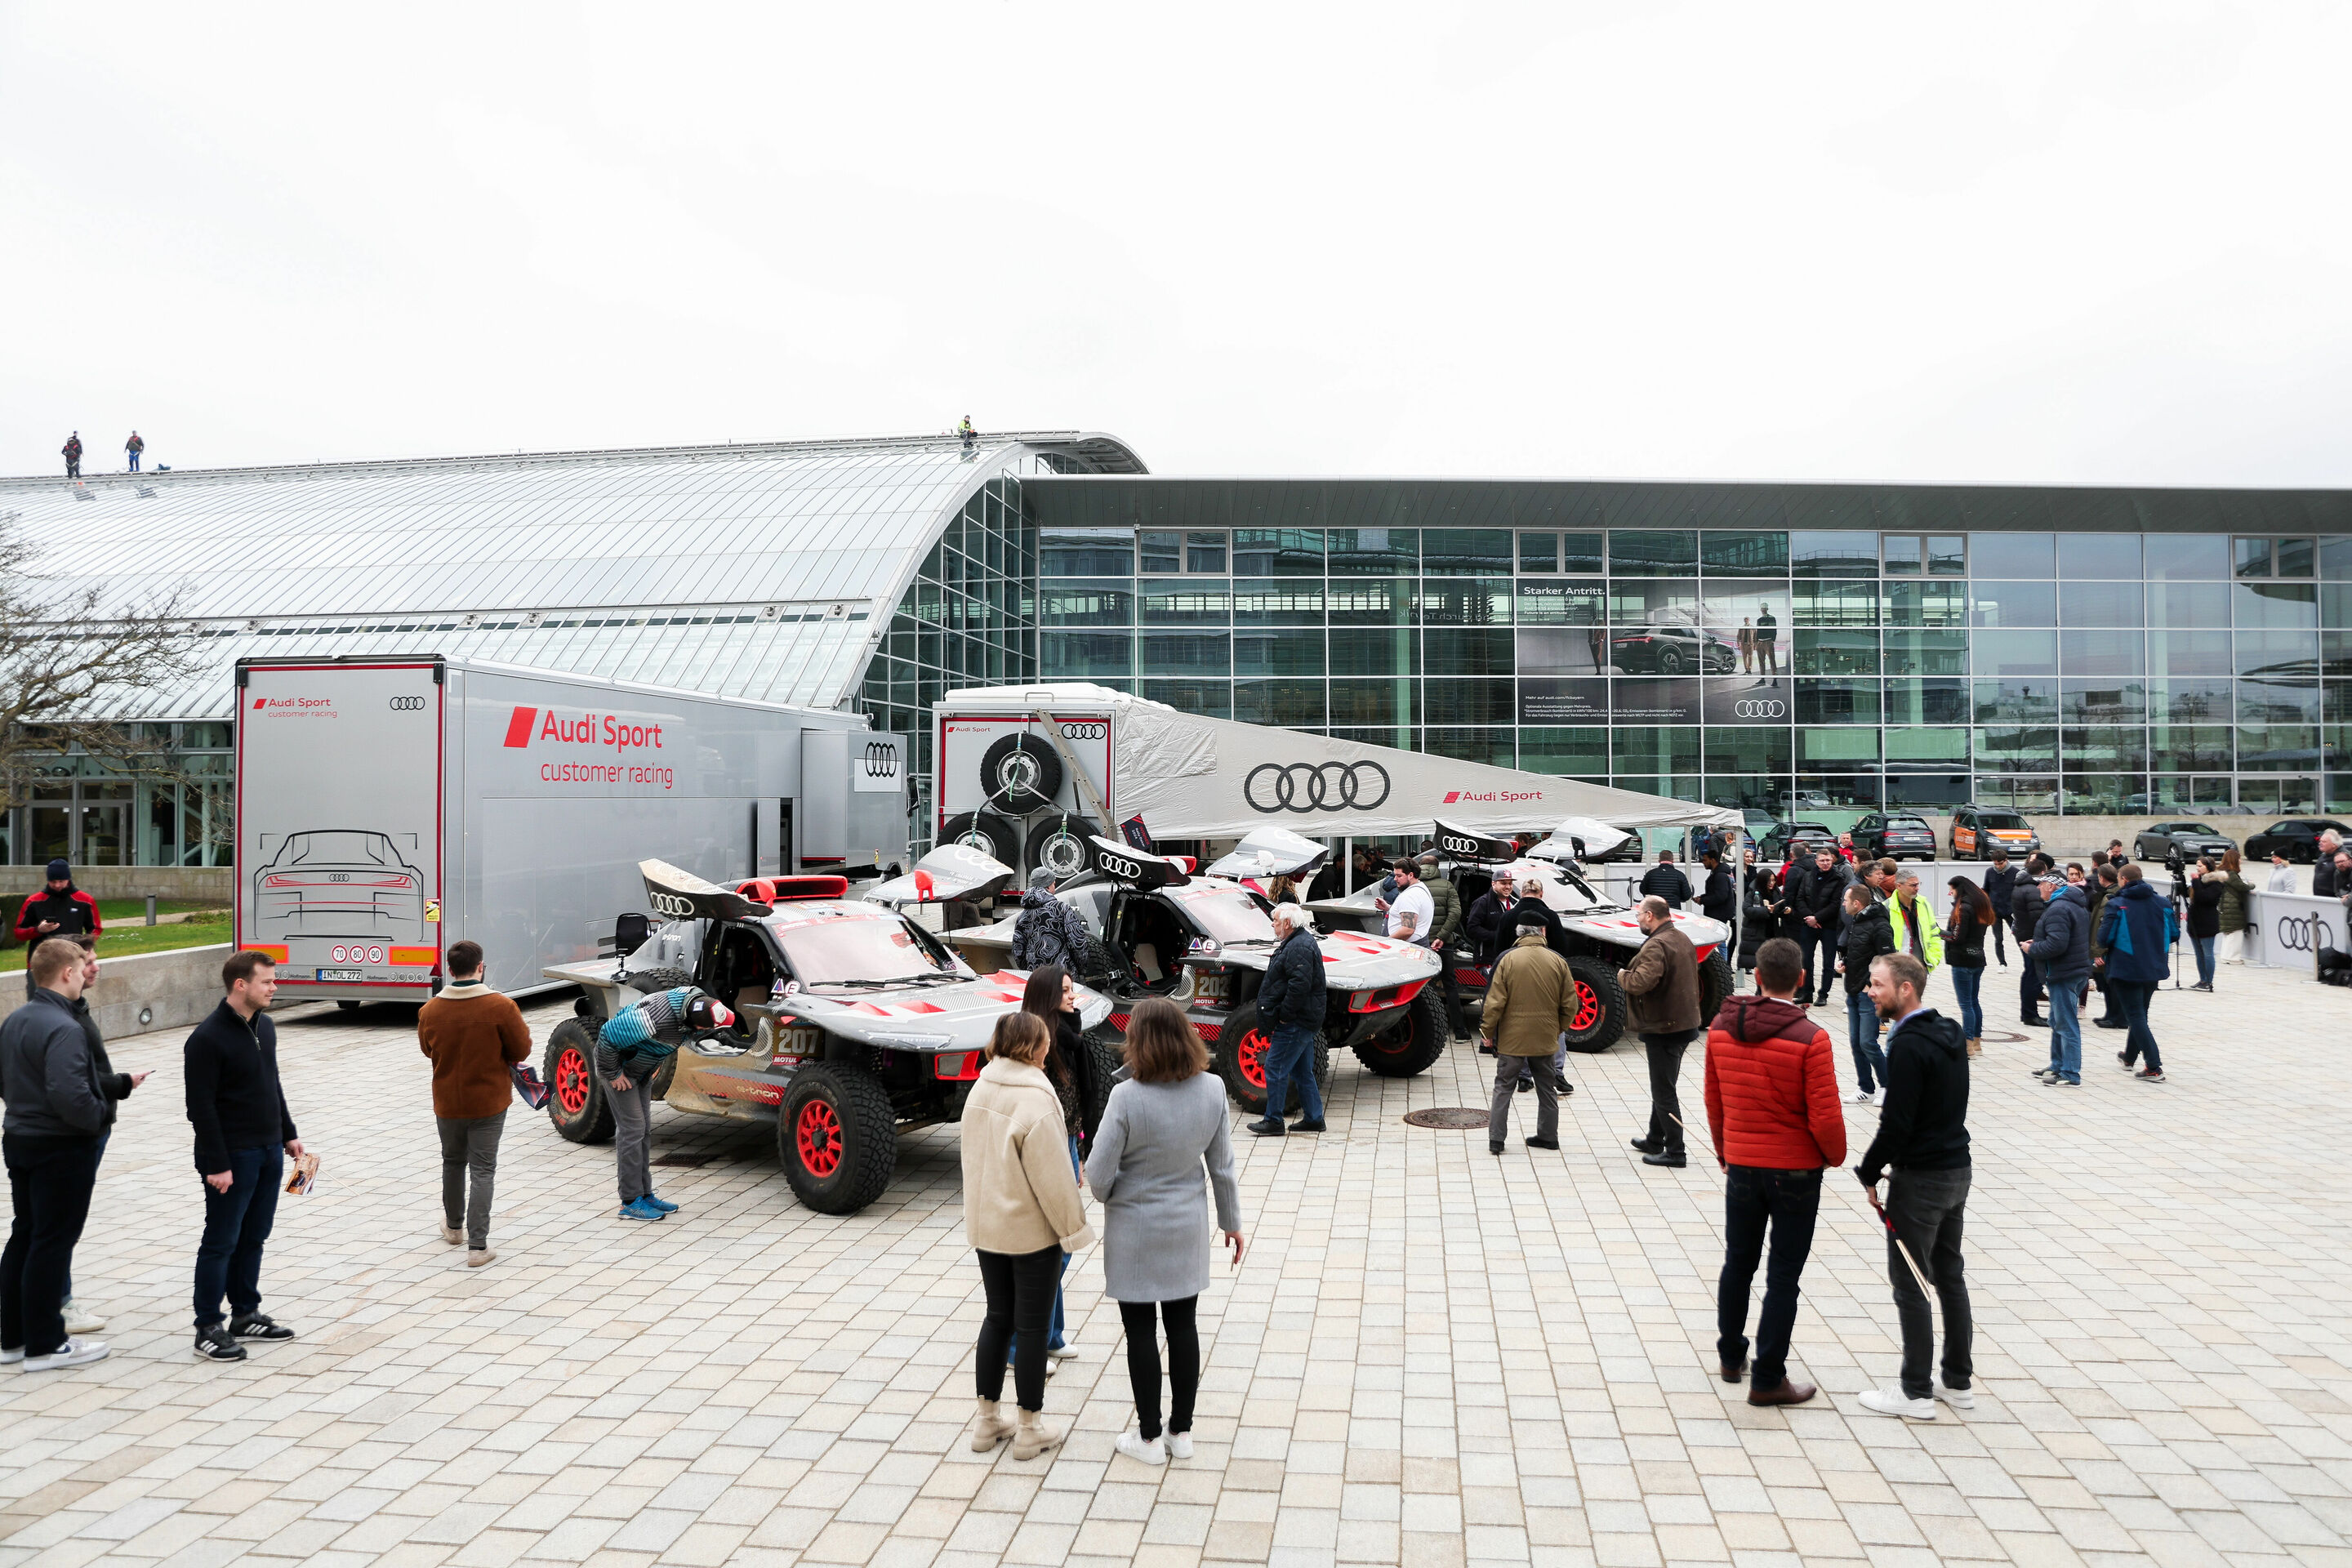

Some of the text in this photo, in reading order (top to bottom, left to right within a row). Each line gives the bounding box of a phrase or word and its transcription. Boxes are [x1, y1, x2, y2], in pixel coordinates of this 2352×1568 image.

[1524, 586, 1606, 595] Starker Antritt.
[269, 697, 331, 708] Audi Sport
[540, 710, 662, 754] Audi Sport
[541, 761, 673, 790] customer racing
[1463, 791, 1543, 803] Audi Sport
[336, 949, 344, 959] 70
[353, 950, 362, 959] 80
[371, 950, 380, 959] 90
[347, 972, 361, 980] 272
[778, 1028, 819, 1054] 207
[737, 1085, 780, 1099] e-tron
